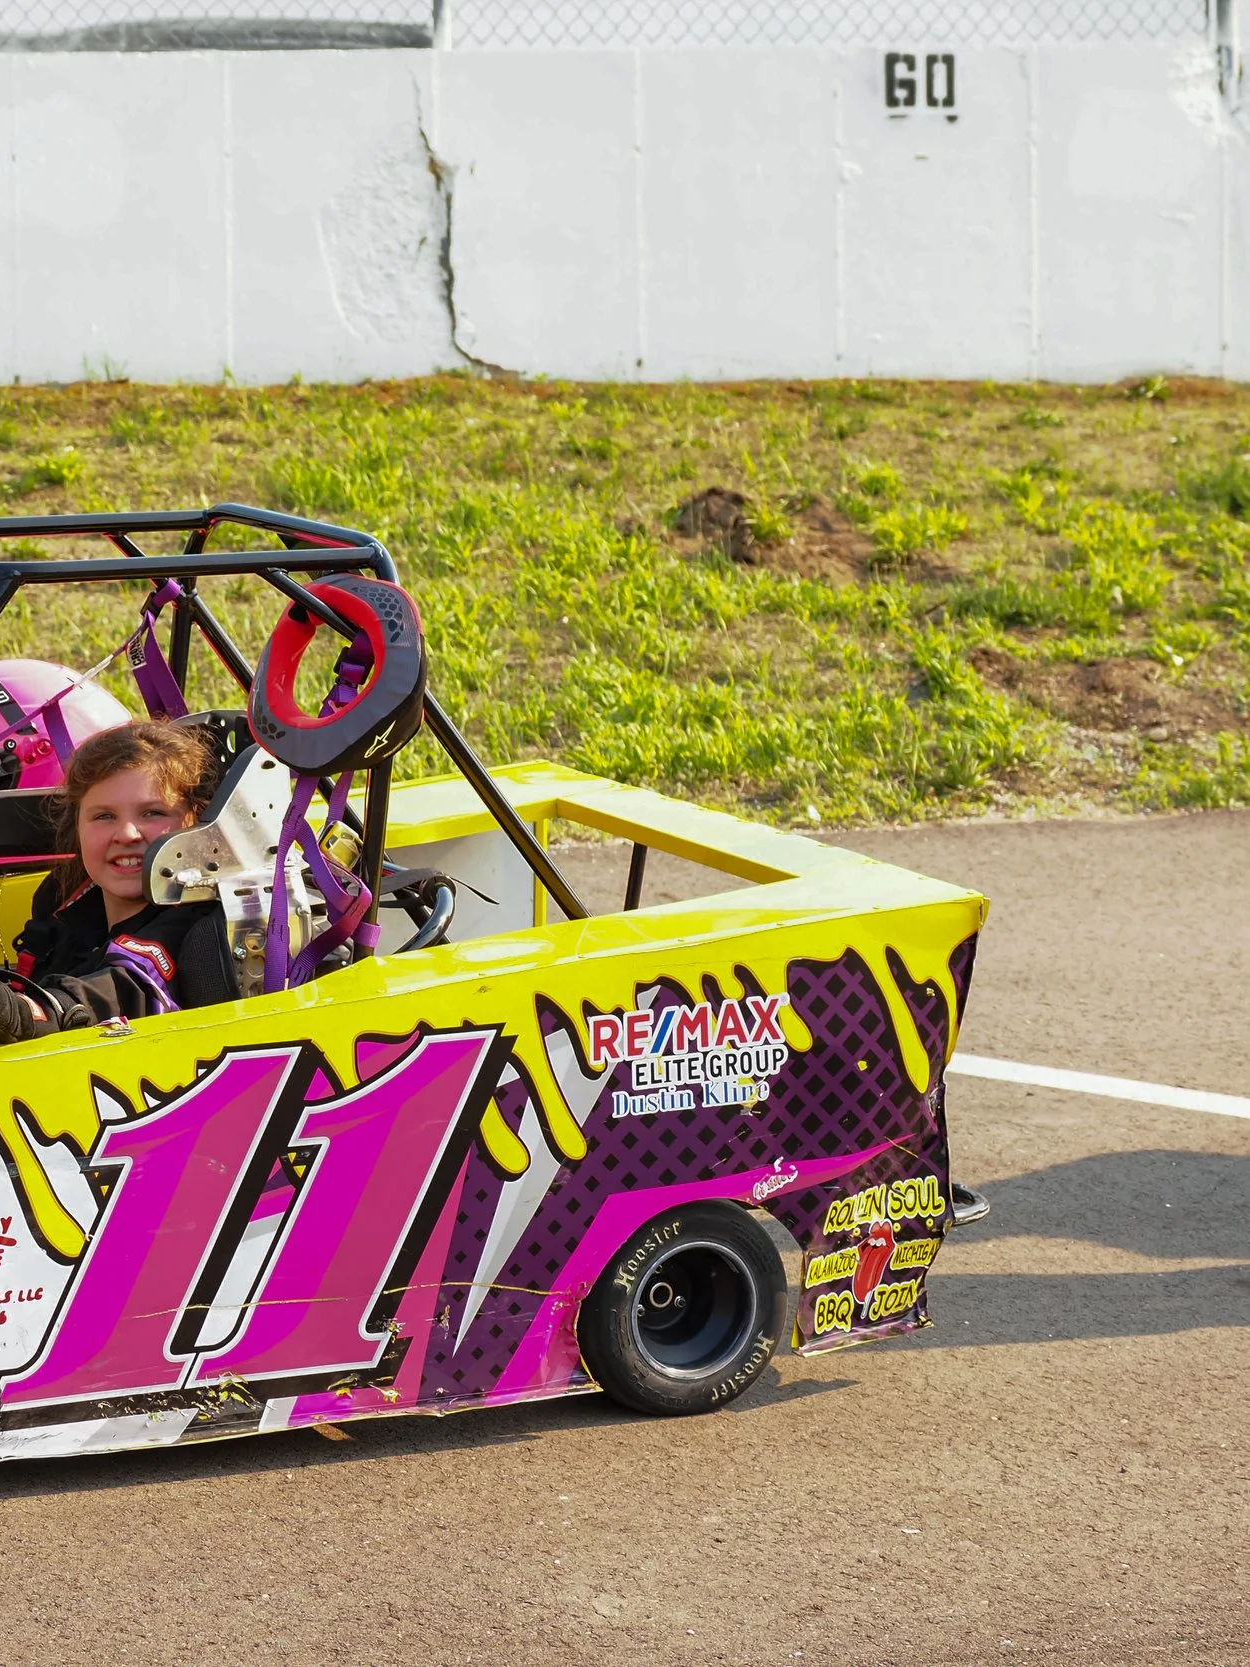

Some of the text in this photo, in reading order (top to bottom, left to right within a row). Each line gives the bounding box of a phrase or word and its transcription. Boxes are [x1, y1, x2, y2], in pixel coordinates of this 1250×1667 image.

[885, 53, 955, 107] 60
[593, 998, 782, 1062] RE/MAX
[635, 1048, 785, 1087] ELITE GROUP
[615, 1086, 692, 1117] Dustin
[890, 1180, 944, 1215] SOUL
[613, 1220, 682, 1296] Hoosier
[19, 1287, 44, 1304] LLC
[816, 1298, 852, 1328] BBQ
[710, 1330, 776, 1402] Hoosier
